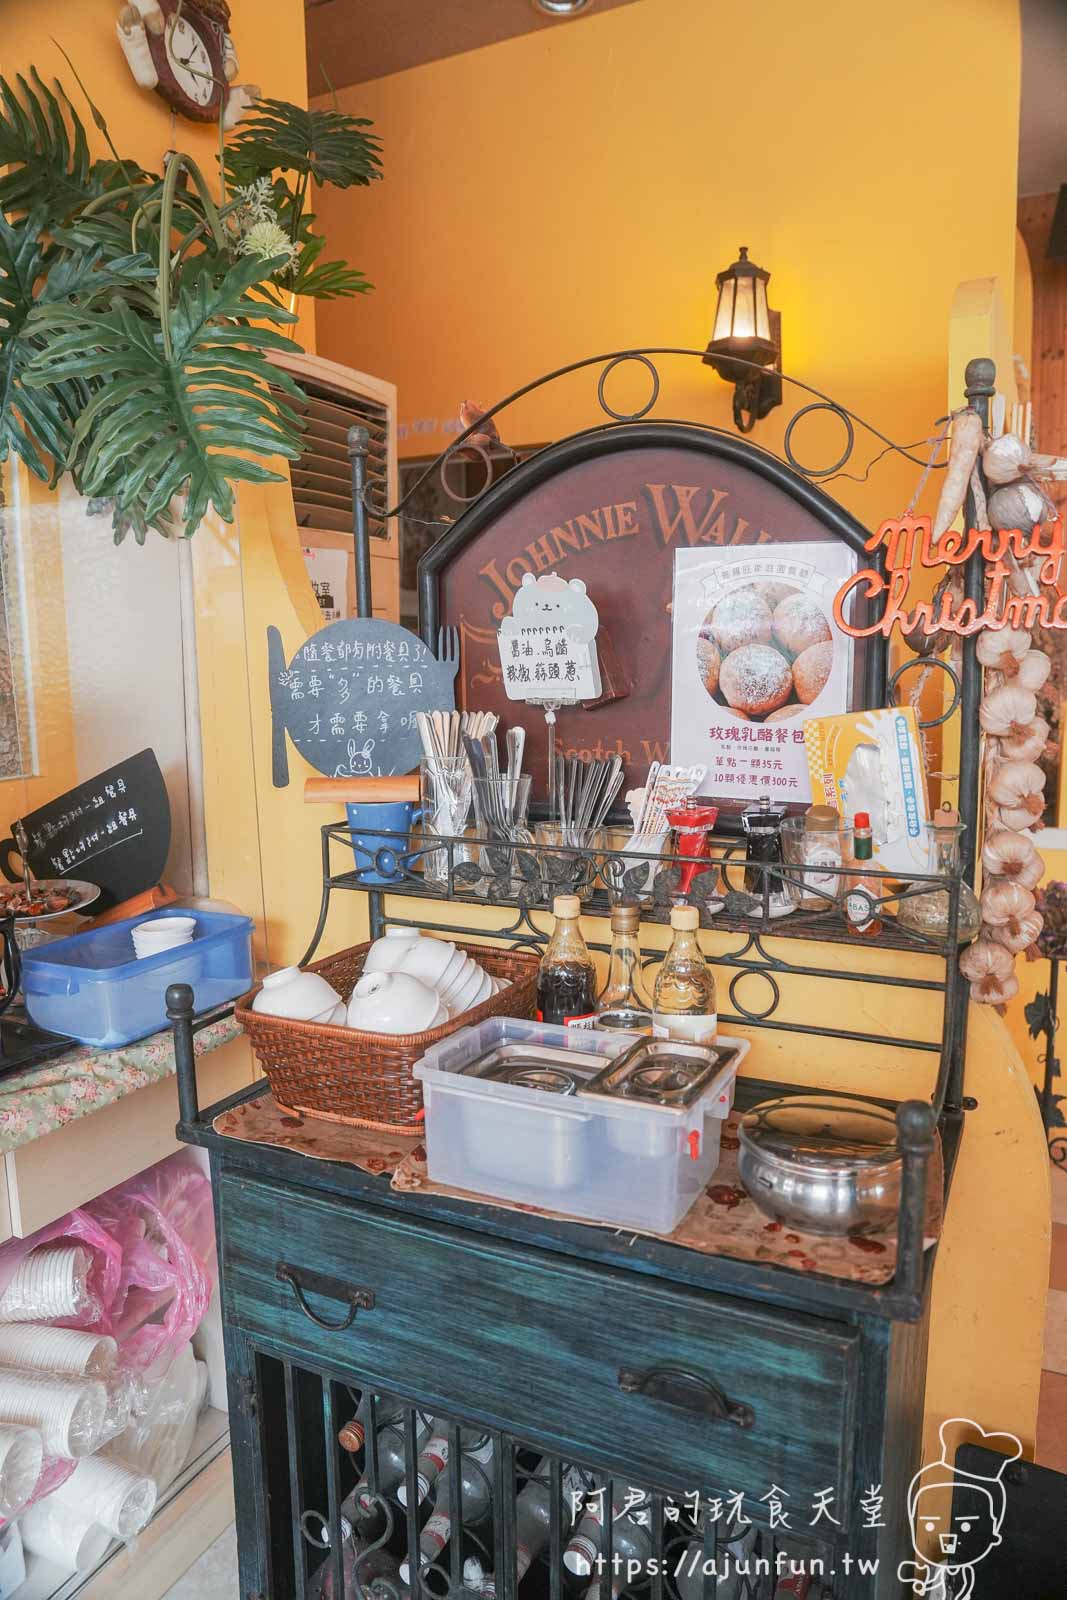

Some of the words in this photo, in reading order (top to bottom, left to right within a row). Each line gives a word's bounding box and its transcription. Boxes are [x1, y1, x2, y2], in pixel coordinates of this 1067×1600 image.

[864, 513, 1064, 585] Merry
[480, 500, 640, 619] JOHNNIE
[708, 726, 806, 744] 玫瑰乳酪餐包
[715, 756, 784, 770] 單點一顆35元
[713, 773, 799, 788] 10顆優惠價300元
